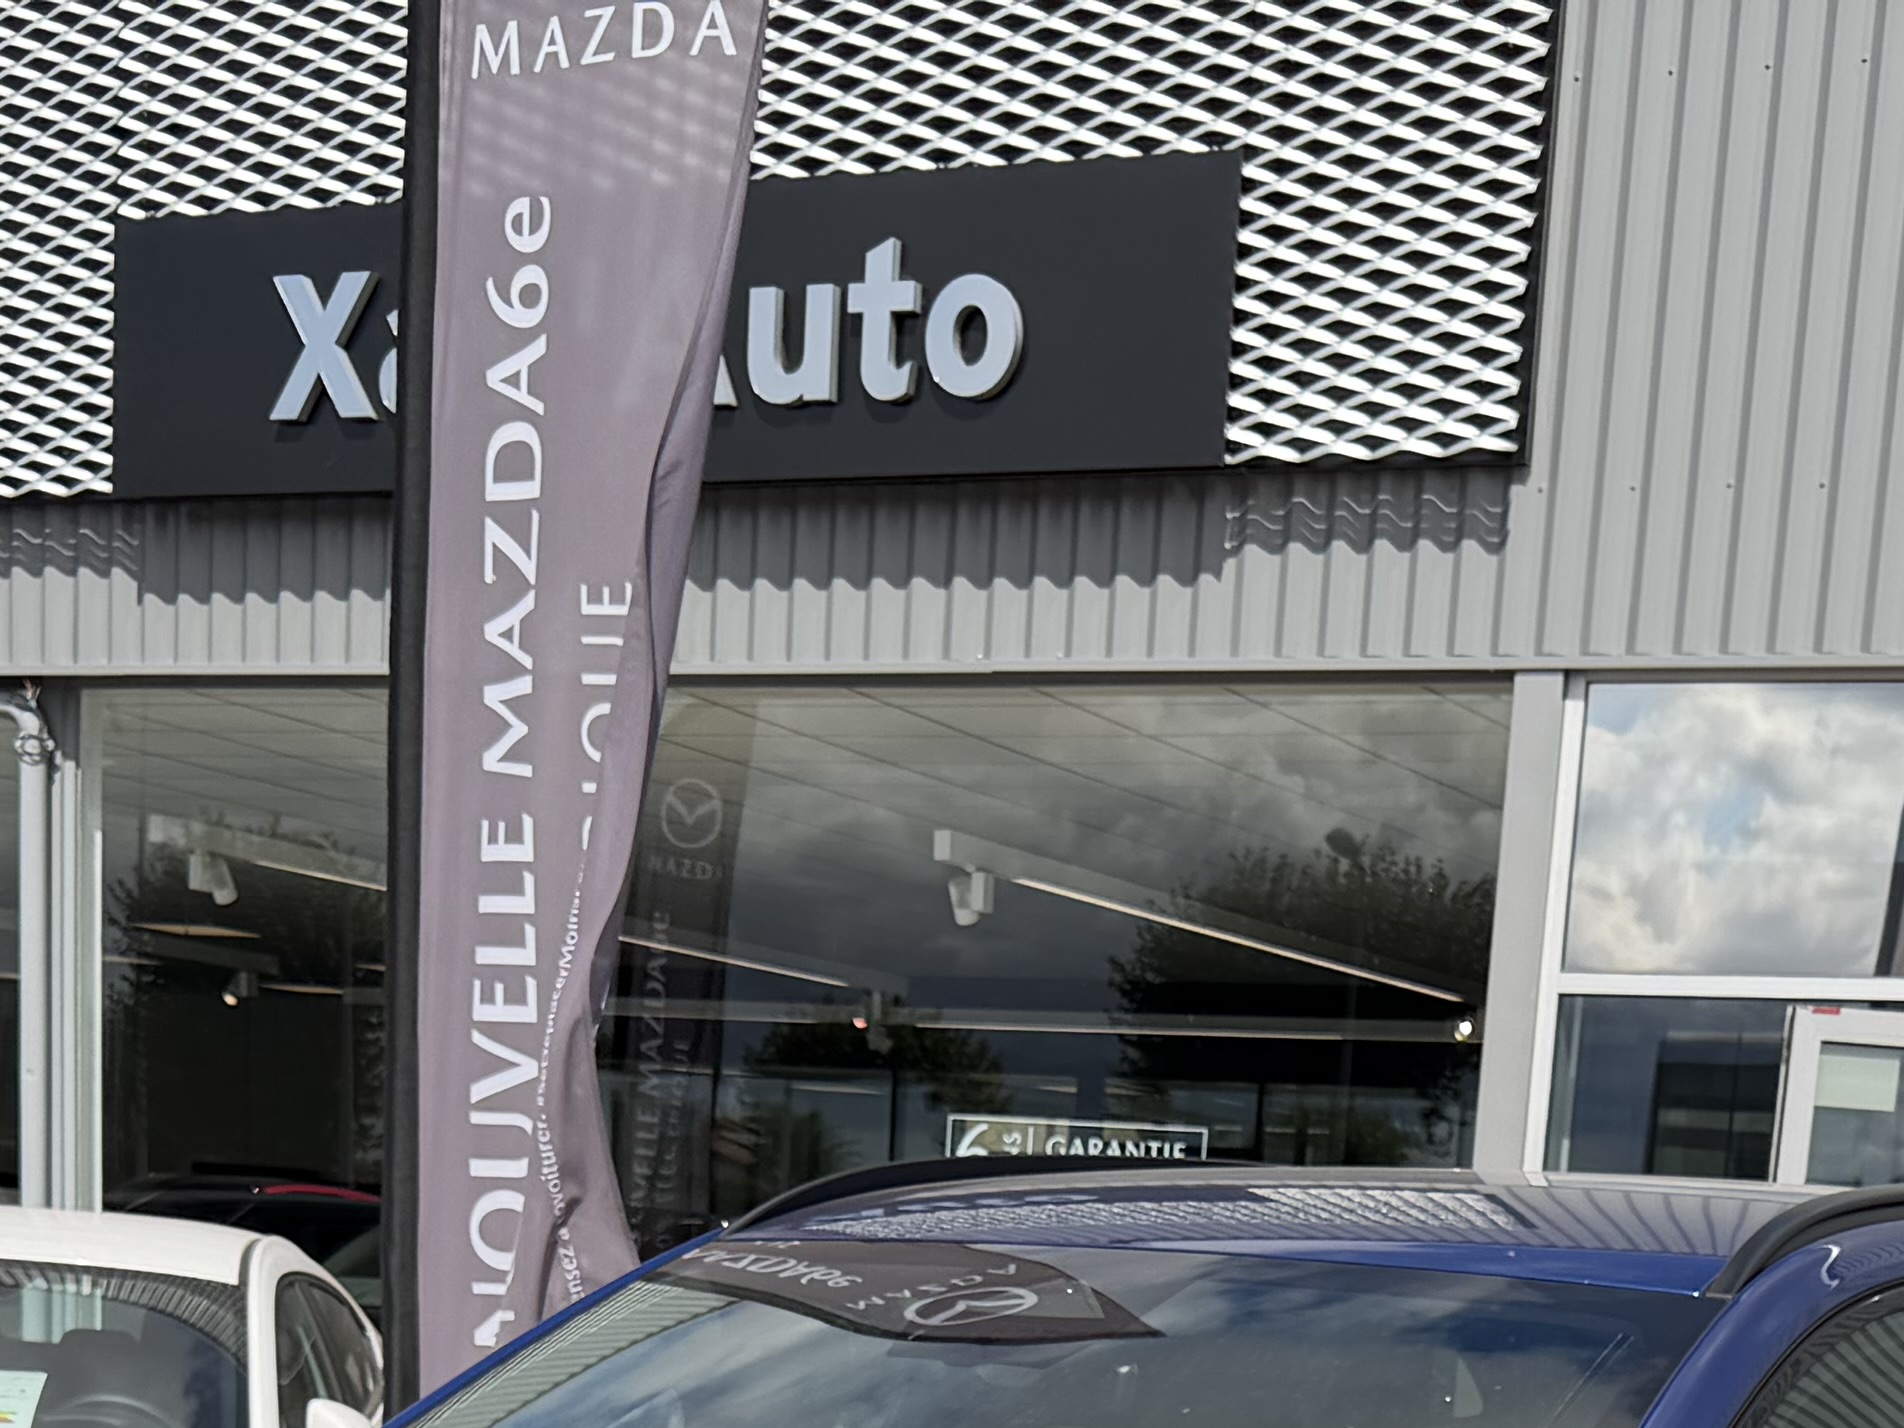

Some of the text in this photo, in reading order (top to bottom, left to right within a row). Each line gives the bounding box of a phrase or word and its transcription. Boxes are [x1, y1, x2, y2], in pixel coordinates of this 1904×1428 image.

[471, 0, 737, 79] MAZDA
[710, 236, 1024, 409] uto
[481, 195, 553, 779] MAZDA6e
